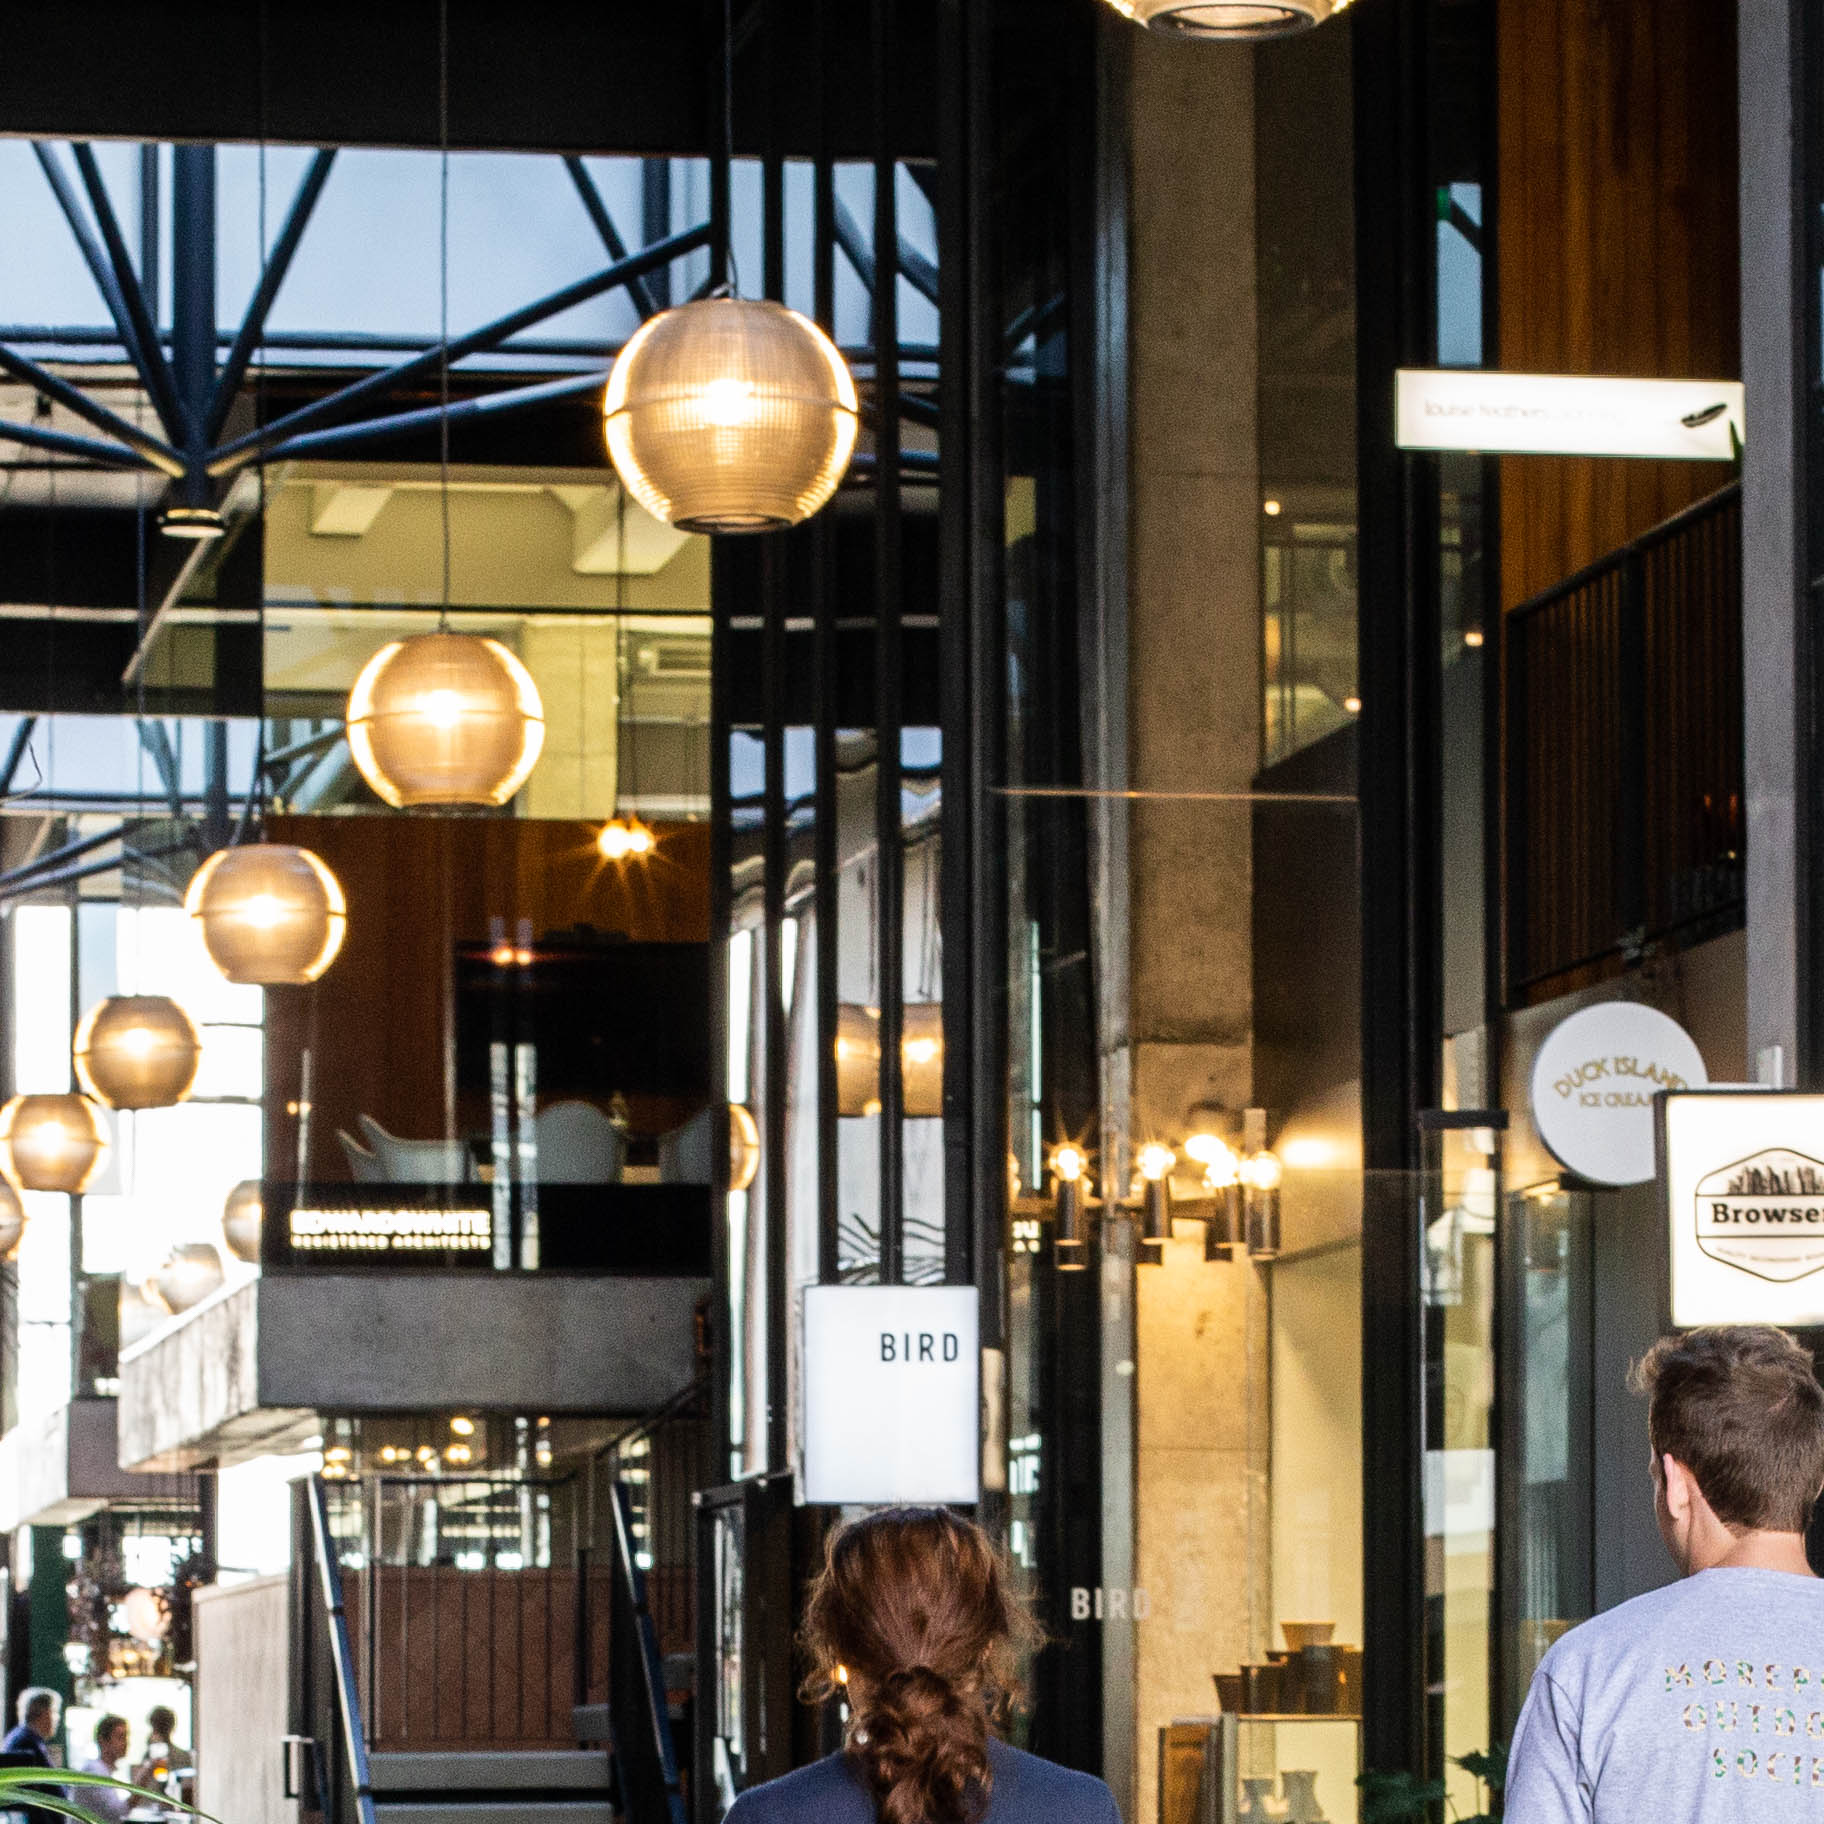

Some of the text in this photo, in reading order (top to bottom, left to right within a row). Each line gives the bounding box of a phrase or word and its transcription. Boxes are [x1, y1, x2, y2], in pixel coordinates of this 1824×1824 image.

[1552, 1057, 1610, 1098] DUCK
[880, 1332, 960, 1362] BIRD
[1070, 1586, 1152, 1621] BIRD
